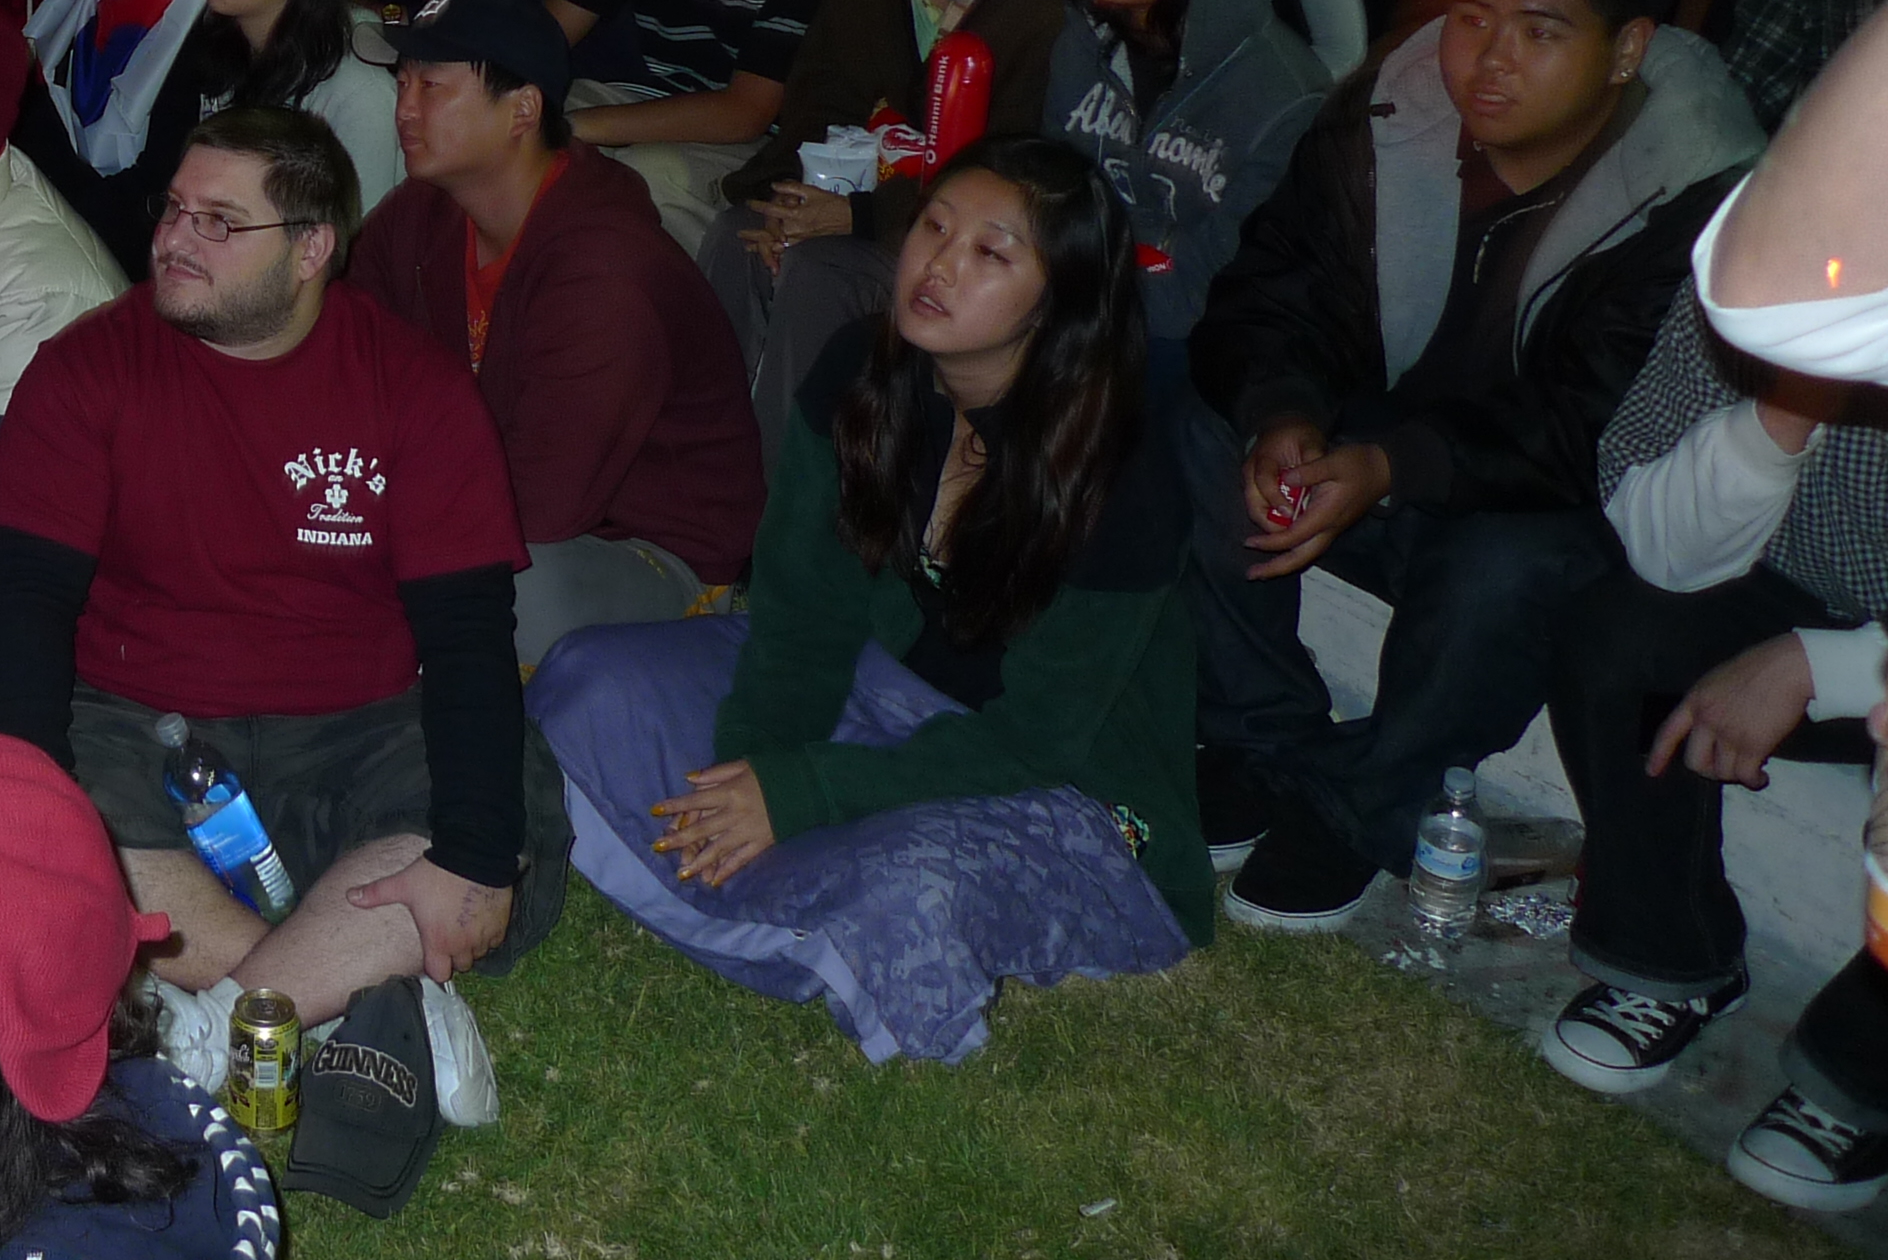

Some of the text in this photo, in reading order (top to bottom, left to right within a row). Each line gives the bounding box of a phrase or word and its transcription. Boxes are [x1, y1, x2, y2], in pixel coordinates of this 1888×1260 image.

[928, 54, 950, 146] Hanmi Bank
[284, 447, 387, 495] Nick's
[297, 528, 373, 546] INDIANA
[307, 503, 364, 523] Tradition
[313, 1040, 418, 1108] GUINNESS
